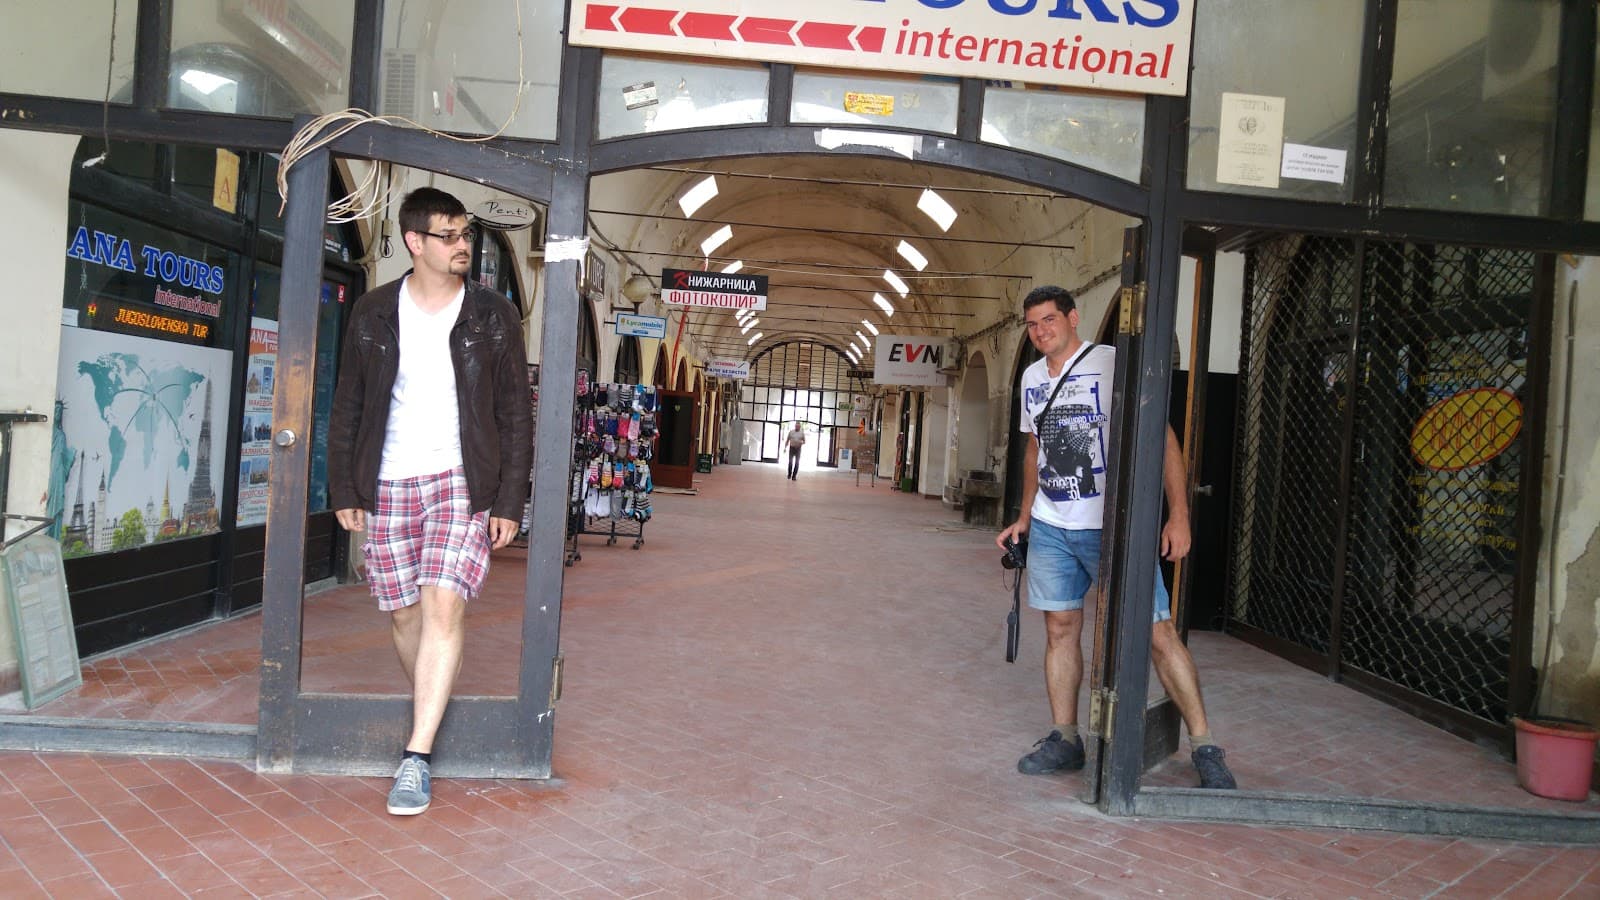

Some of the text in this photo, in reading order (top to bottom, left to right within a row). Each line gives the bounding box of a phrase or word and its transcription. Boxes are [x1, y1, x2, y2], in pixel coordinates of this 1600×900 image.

[895, 19, 1174, 79] international
[487, 201, 528, 216] Penti
[67, 226, 224, 294] ANA TOURS
[673, 271, 757, 292] КНИЖАРНИЦА
[154, 284, 221, 317] international
[669, 291, 758, 309] ФОТОКОПИР
[114, 308, 209, 338] JUGOSLOVENSKA TUR
[888, 343, 940, 364] EVN
